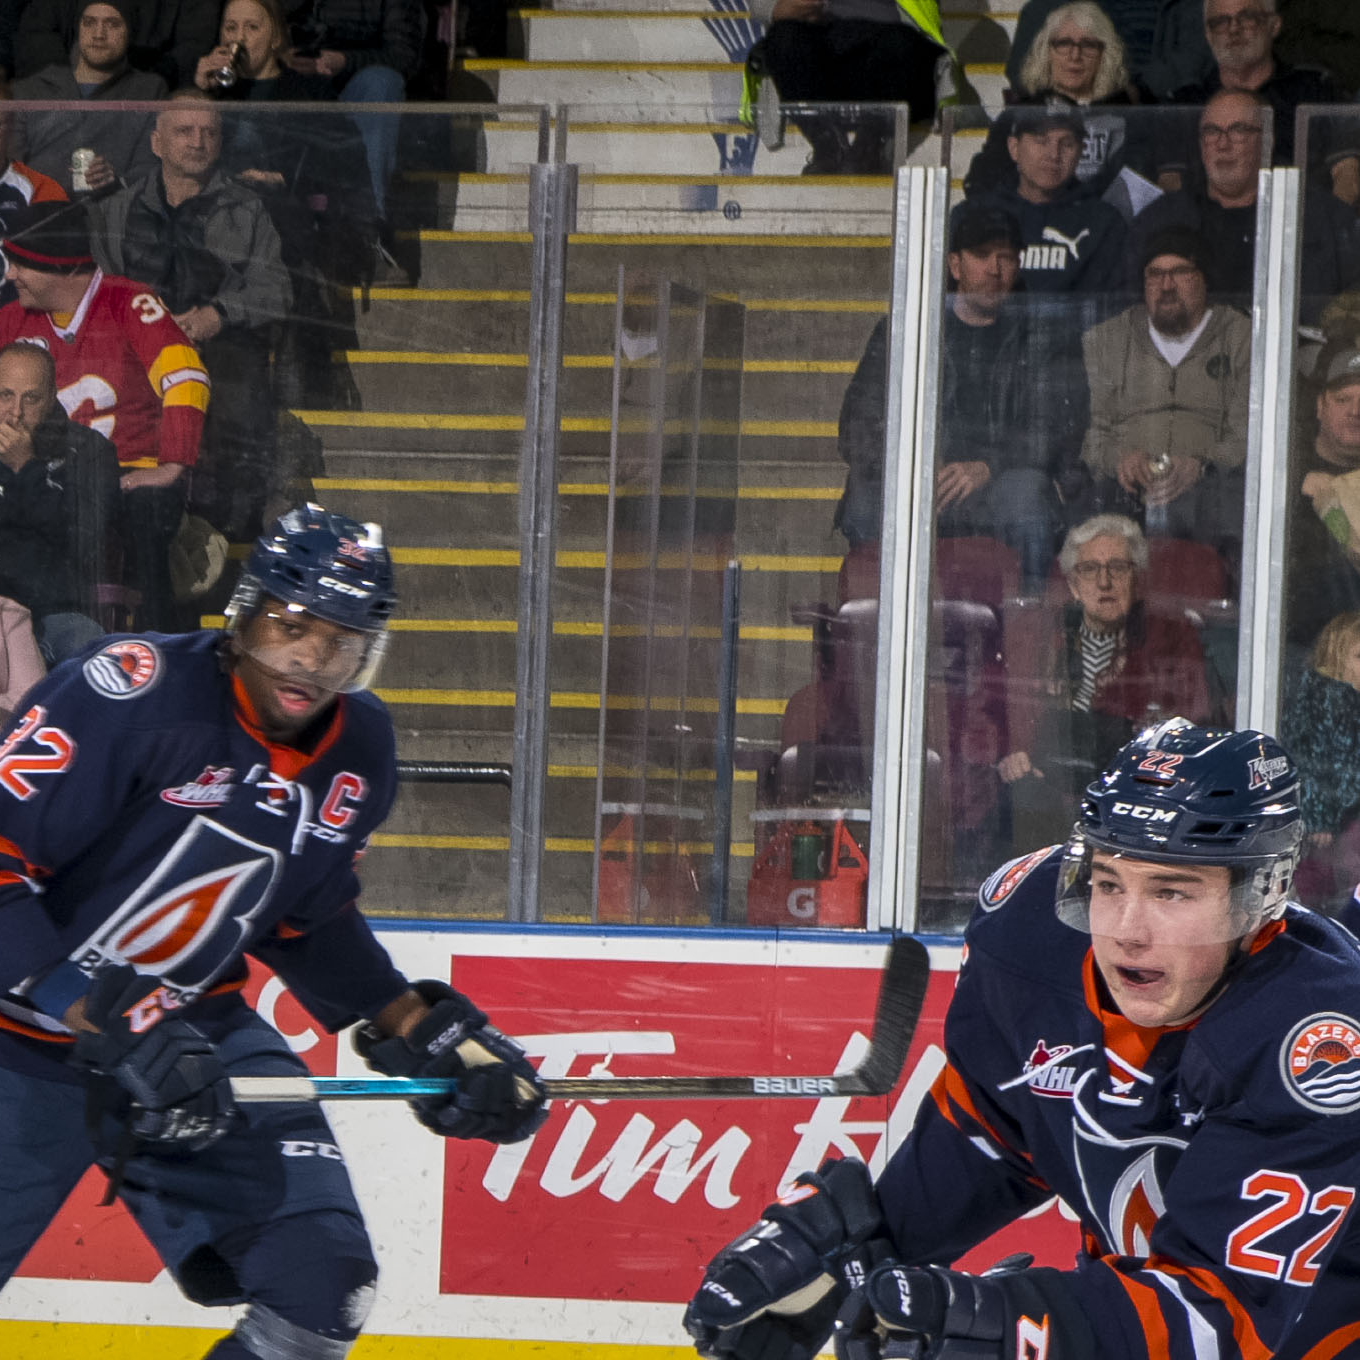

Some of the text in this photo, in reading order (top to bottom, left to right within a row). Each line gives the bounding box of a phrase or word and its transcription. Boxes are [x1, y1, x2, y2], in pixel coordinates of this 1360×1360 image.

[1138, 751, 1184, 777] 22
[319, 769, 366, 830] C
[1111, 802, 1178, 824] CCM
[787, 887, 816, 919] G
[1225, 1168, 1356, 1287] 22
